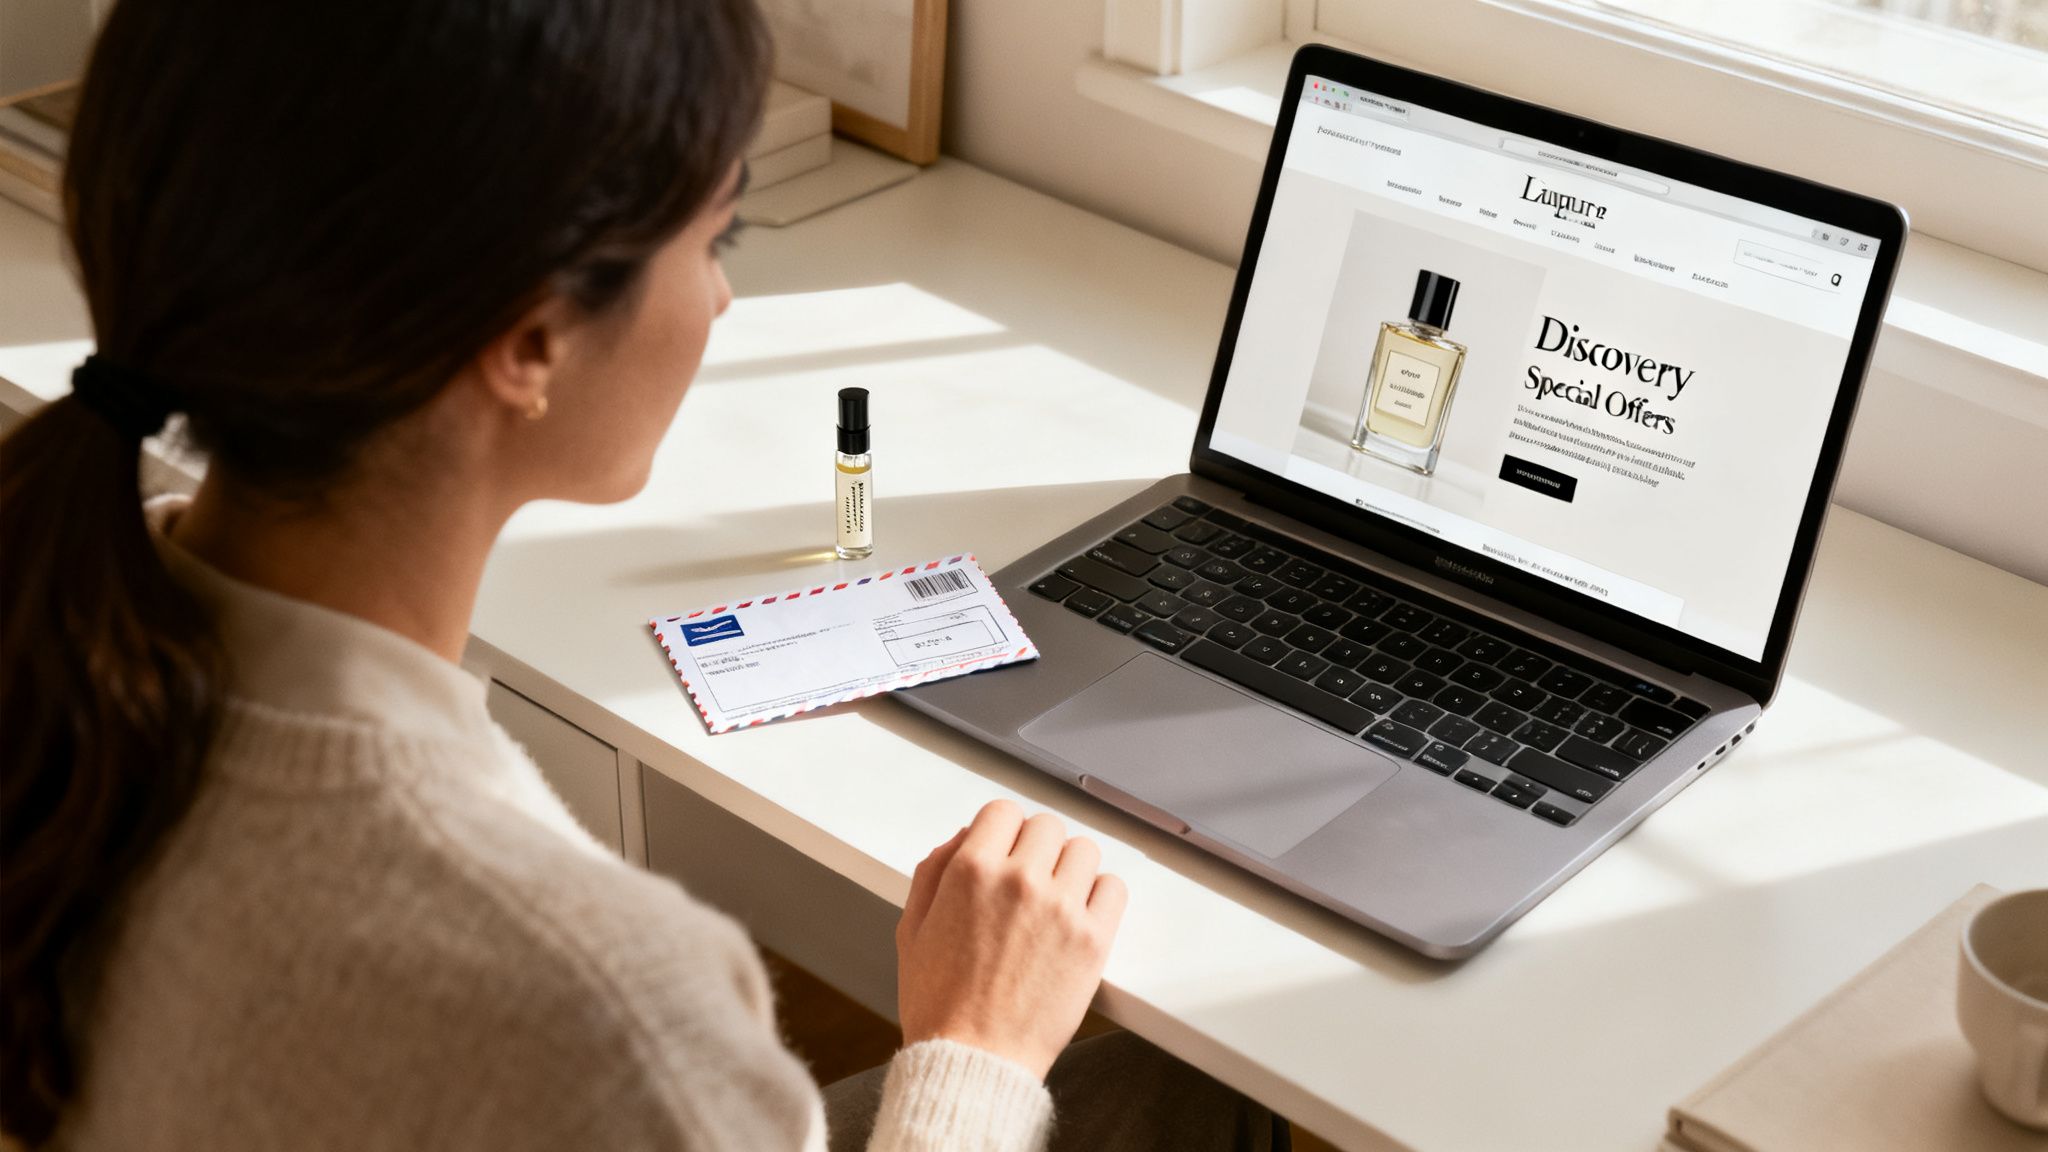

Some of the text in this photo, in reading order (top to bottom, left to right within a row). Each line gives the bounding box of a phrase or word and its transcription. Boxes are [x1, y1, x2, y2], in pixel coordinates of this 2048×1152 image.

[1534, 315, 1696, 402] Discovery
[1524, 365, 1676, 435] Special Offers
